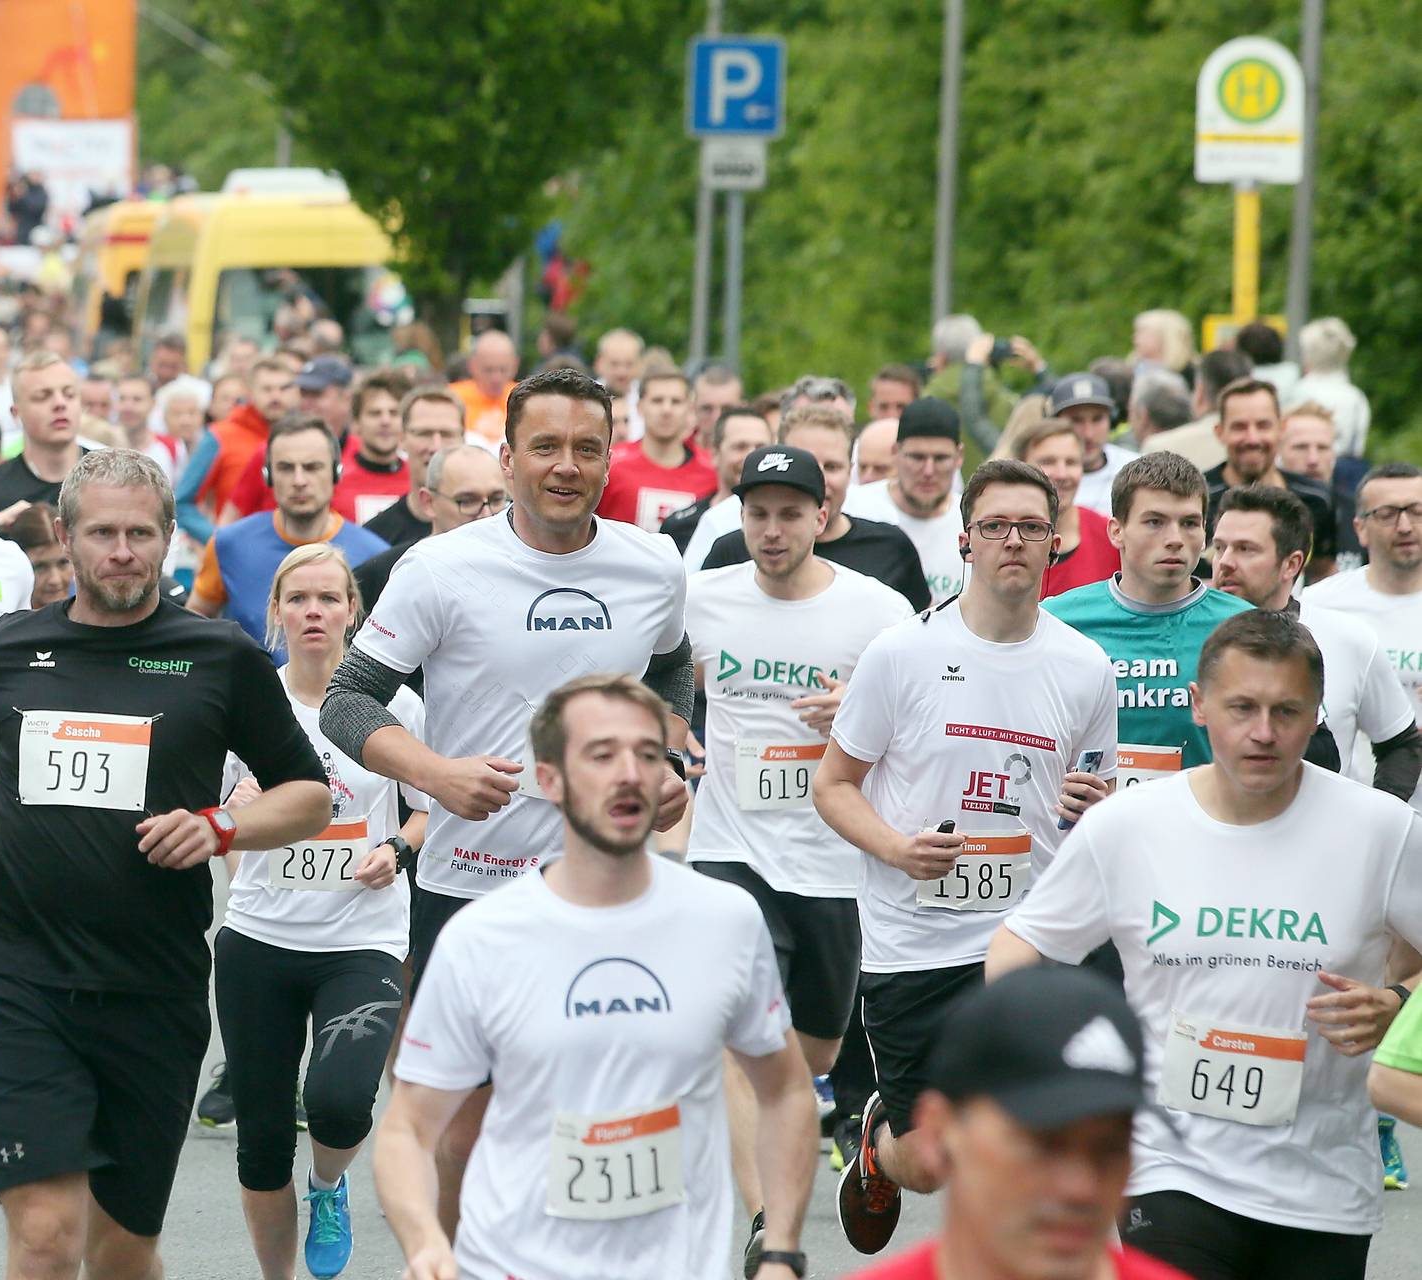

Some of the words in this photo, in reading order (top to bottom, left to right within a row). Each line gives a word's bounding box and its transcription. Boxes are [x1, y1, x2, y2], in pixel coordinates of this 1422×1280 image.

[710, 49, 763, 125] P
[534, 617, 604, 631] MAN
[128, 656, 194, 673] CrossHIT
[1111, 658, 1178, 678] eam
[942, 674, 965, 682] erima
[1118, 683, 1190, 708] nkra
[65, 725, 101, 738] Sascha
[947, 727, 970, 735] LICHT
[979, 730, 998, 739] LUFT.
[999, 732, 1013, 741] MIT
[1014, 734, 1056, 749] SICHERHEIT.
[769, 749, 799, 759] Patrick
[46, 750, 111, 794] 593
[759, 768, 809, 800] 619
[962, 770, 1011, 800] JET
[964, 803, 991, 811] VELUX
[283, 847, 354, 881] 2872
[454, 848, 480, 861] MAN
[483, 854, 527, 868] Energy
[451, 860, 484, 875] Future
[486, 867, 497, 877] in
[500, 869, 519, 878] the
[934, 863, 1013, 899] 1585
[1197, 907, 1328, 945] DEKRA
[1152, 954, 1181, 967] Alles
[1186, 954, 1203, 966] im
[1208, 954, 1261, 969] grünen
[1267, 954, 1323, 973] Bereich
[575, 998, 661, 1016] MAN
[1213, 1035, 1256, 1051] Carsten
[1191, 1058, 1264, 1110] 649
[568, 1148, 665, 1204] 2311
